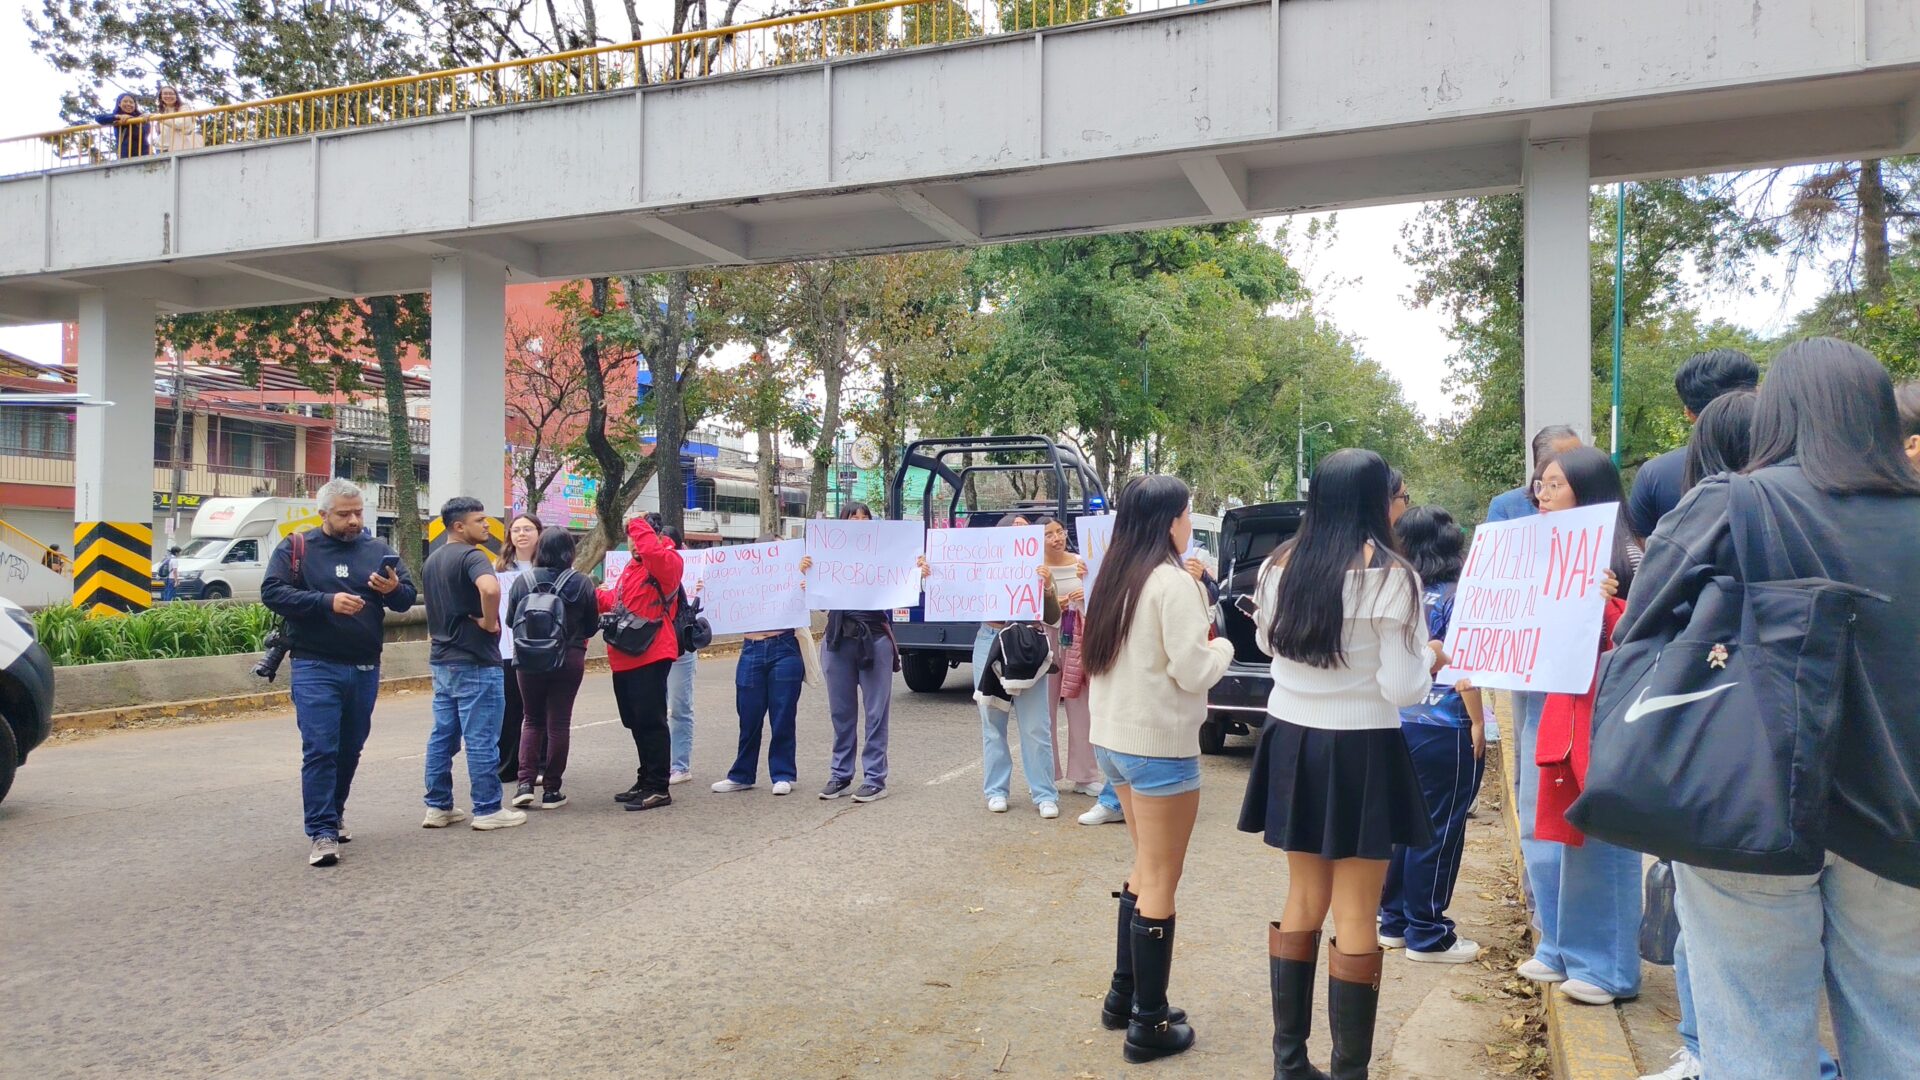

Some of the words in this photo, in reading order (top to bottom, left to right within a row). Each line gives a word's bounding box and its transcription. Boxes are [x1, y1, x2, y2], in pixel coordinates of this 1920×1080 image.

[735, 549, 761, 564] voy
[767, 545, 779, 558] a
[930, 531, 1005, 561] Preescolar
[1014, 536, 1039, 557] NO
[929, 584, 998, 617] Respuesta
[1005, 579, 1044, 620] YA!
[1459, 585, 1520, 621] PRIMERO
[1449, 627, 1541, 683] GOBIERNO!
